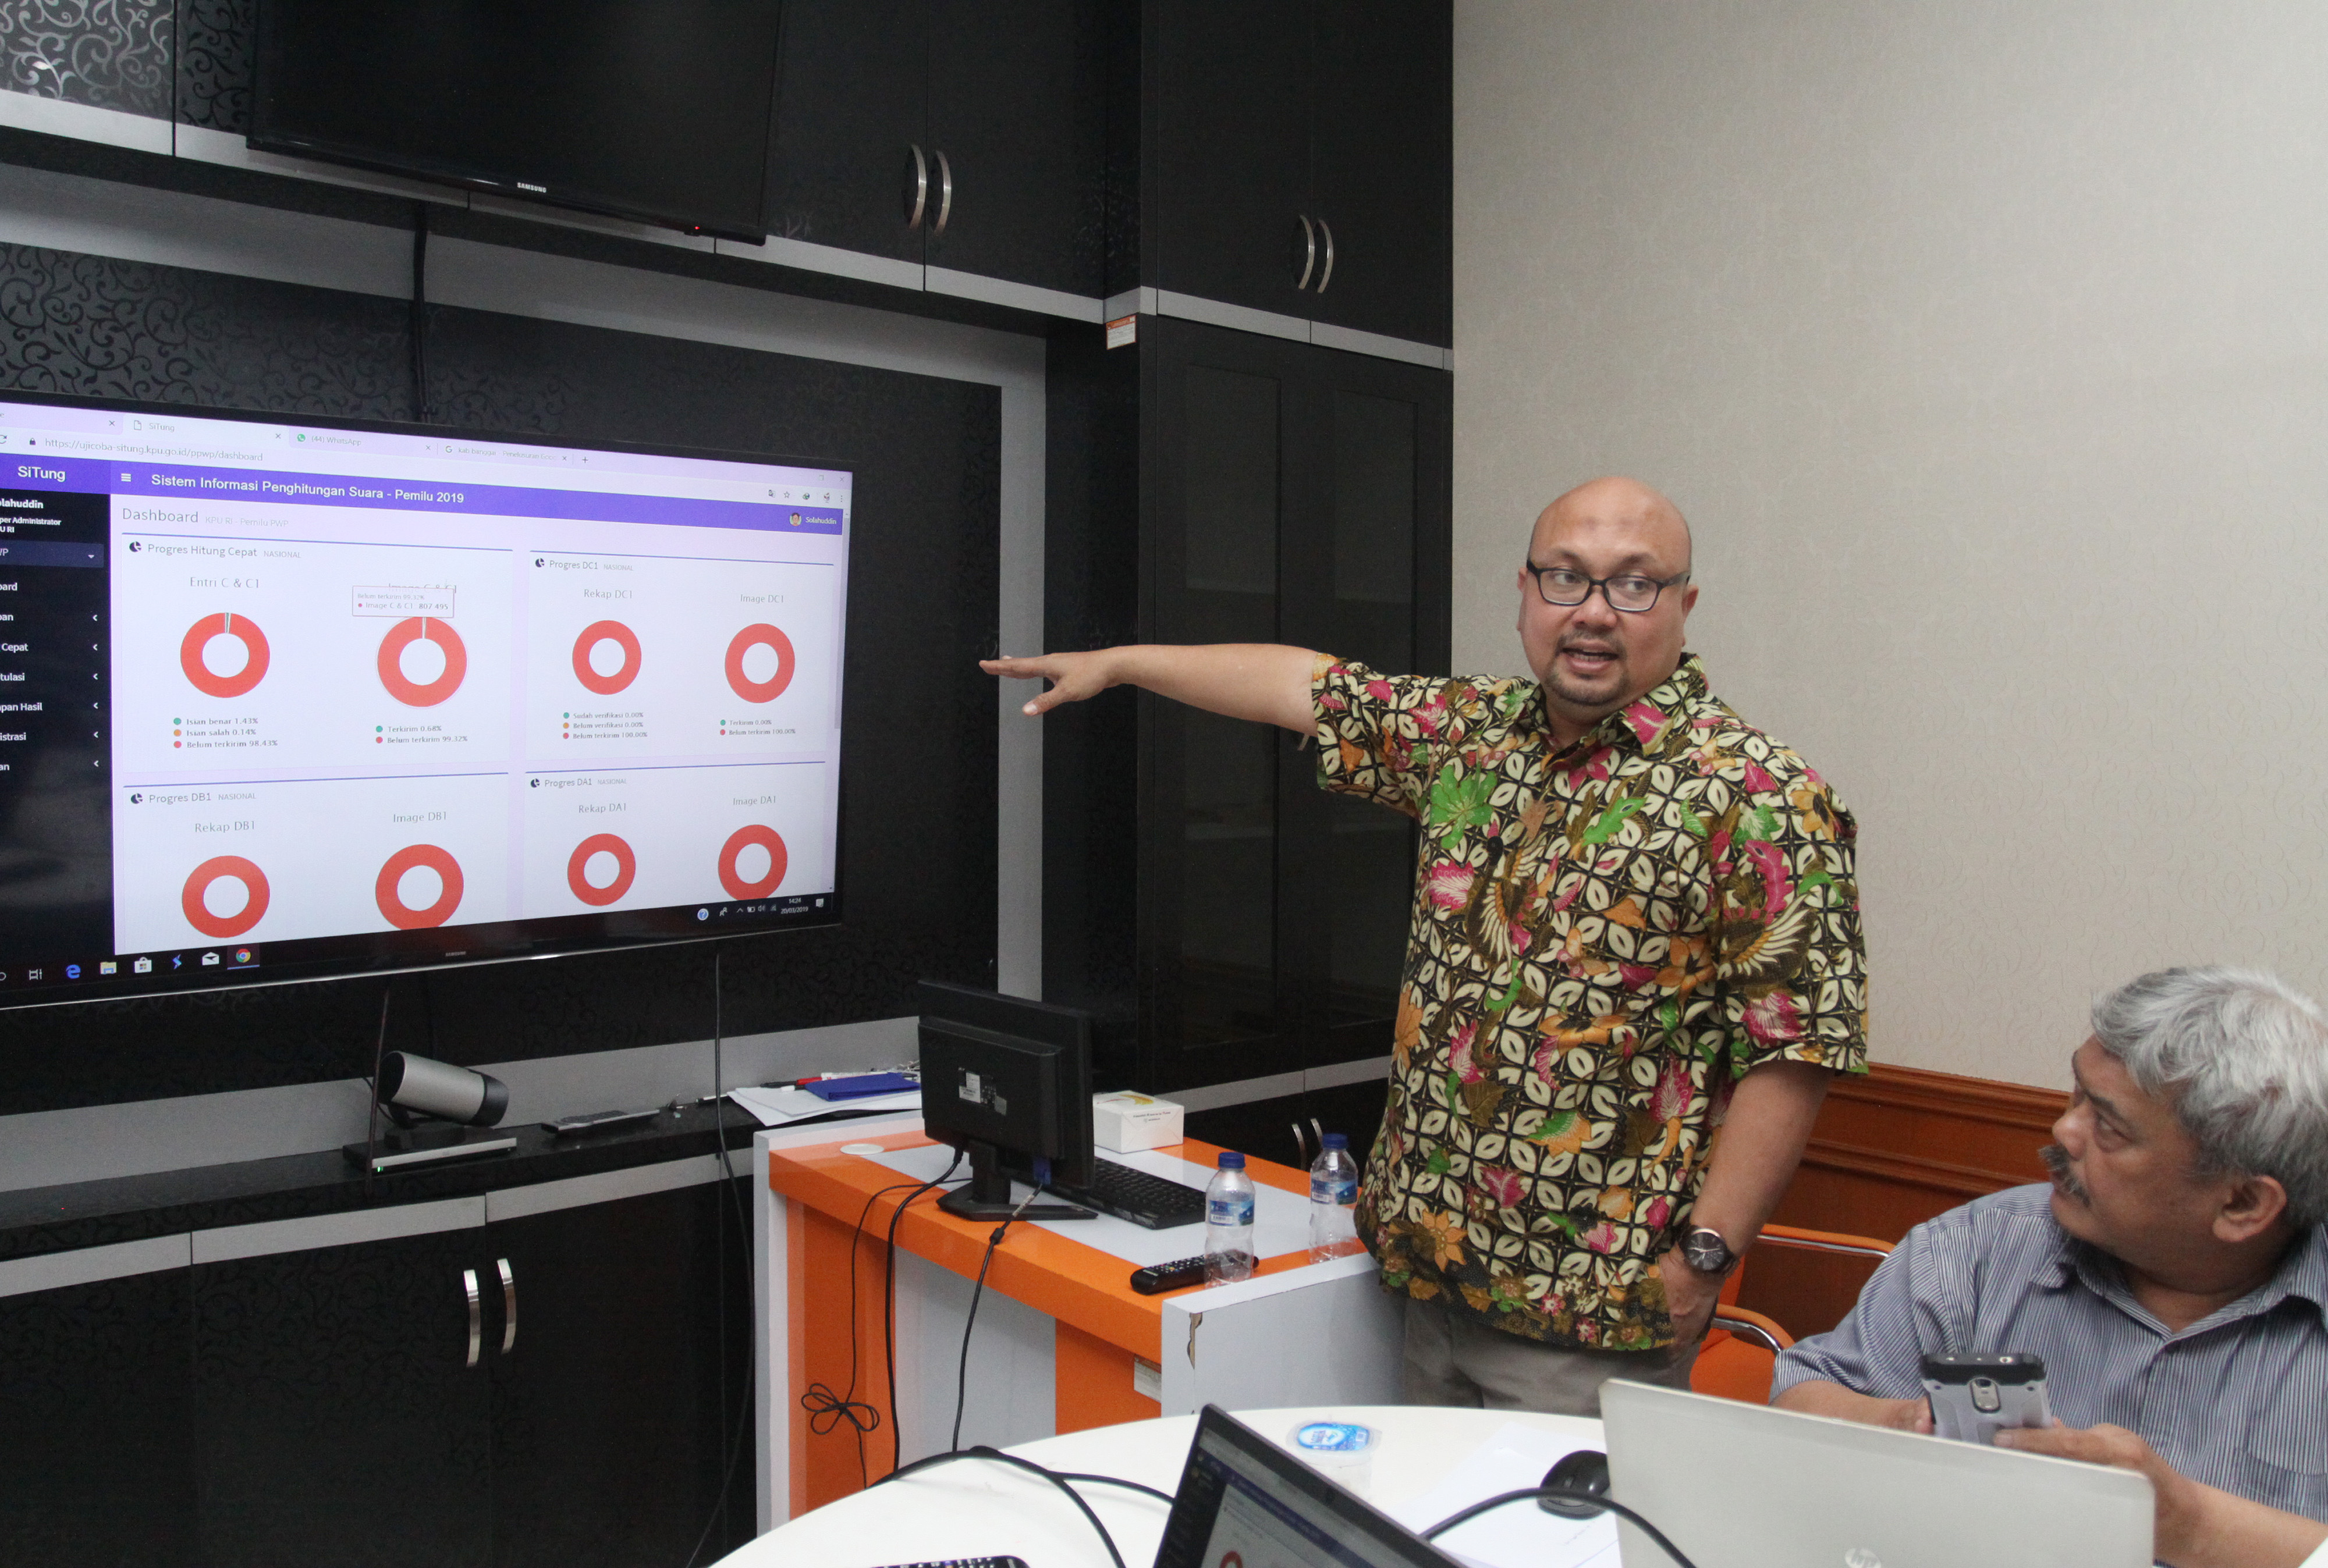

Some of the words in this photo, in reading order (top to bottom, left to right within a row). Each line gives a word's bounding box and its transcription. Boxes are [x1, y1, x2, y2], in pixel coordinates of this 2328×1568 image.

[517, 182, 546, 193] SAMSUNG
[149, 422, 175, 432] SiTung
[327, 437, 361, 446] WhatsApp
[17, 465, 66, 482] SiTung
[151, 474, 196, 488] Sistem
[200, 477, 258, 491] Informasi
[262, 481, 345, 497] Penghitungan
[349, 486, 384, 499] Suara
[395, 489, 433, 502] Pemilu
[436, 492, 464, 503] 2019
[0, 498, 44, 509] lahuddin
[12, 517, 62, 526] Administrator
[122, 508, 199, 523] Dashboard
[205, 516, 223, 524] KPU
[225, 517, 233, 525] RI
[240, 518, 268, 527] Pemilu
[271, 520, 289, 528] PWP
[805, 517, 837, 525] Solahuddin
[148, 544, 188, 556] Progres
[191, 545, 225, 558] Hitung
[228, 547, 257, 559] Cepat
[264, 550, 301, 559] NASIONAL
[549, 560, 580, 571] Progres
[583, 561, 598, 570] DC1
[190, 577, 217, 588] Entri
[221, 578, 229, 588] C
[233, 578, 242, 588] &
[246, 578, 260, 589] C1
[584, 589, 612, 599] Rekap
[615, 589, 633, 599] DC1
[740, 594, 765, 604] Image
[768, 595, 784, 603] DC1
[2, 643, 29, 653] Cepat
[0, 702, 18, 713] pan
[20, 702, 42, 711] Hasil
[544, 779, 575, 789] Progres
[577, 778, 592, 786] DA1
[149, 794, 188, 805] Progres
[191, 792, 212, 802] DB1
[218, 792, 257, 801] NASIONAL
[733, 798, 758, 806] Image
[760, 796, 776, 804] DA1
[579, 804, 606, 814] Rekap
[609, 802, 627, 812] DA1
[393, 814, 424, 824] Image
[428, 811, 446, 821] DB1
[195, 822, 230, 833] Rekap
[234, 820, 255, 831] DB1
